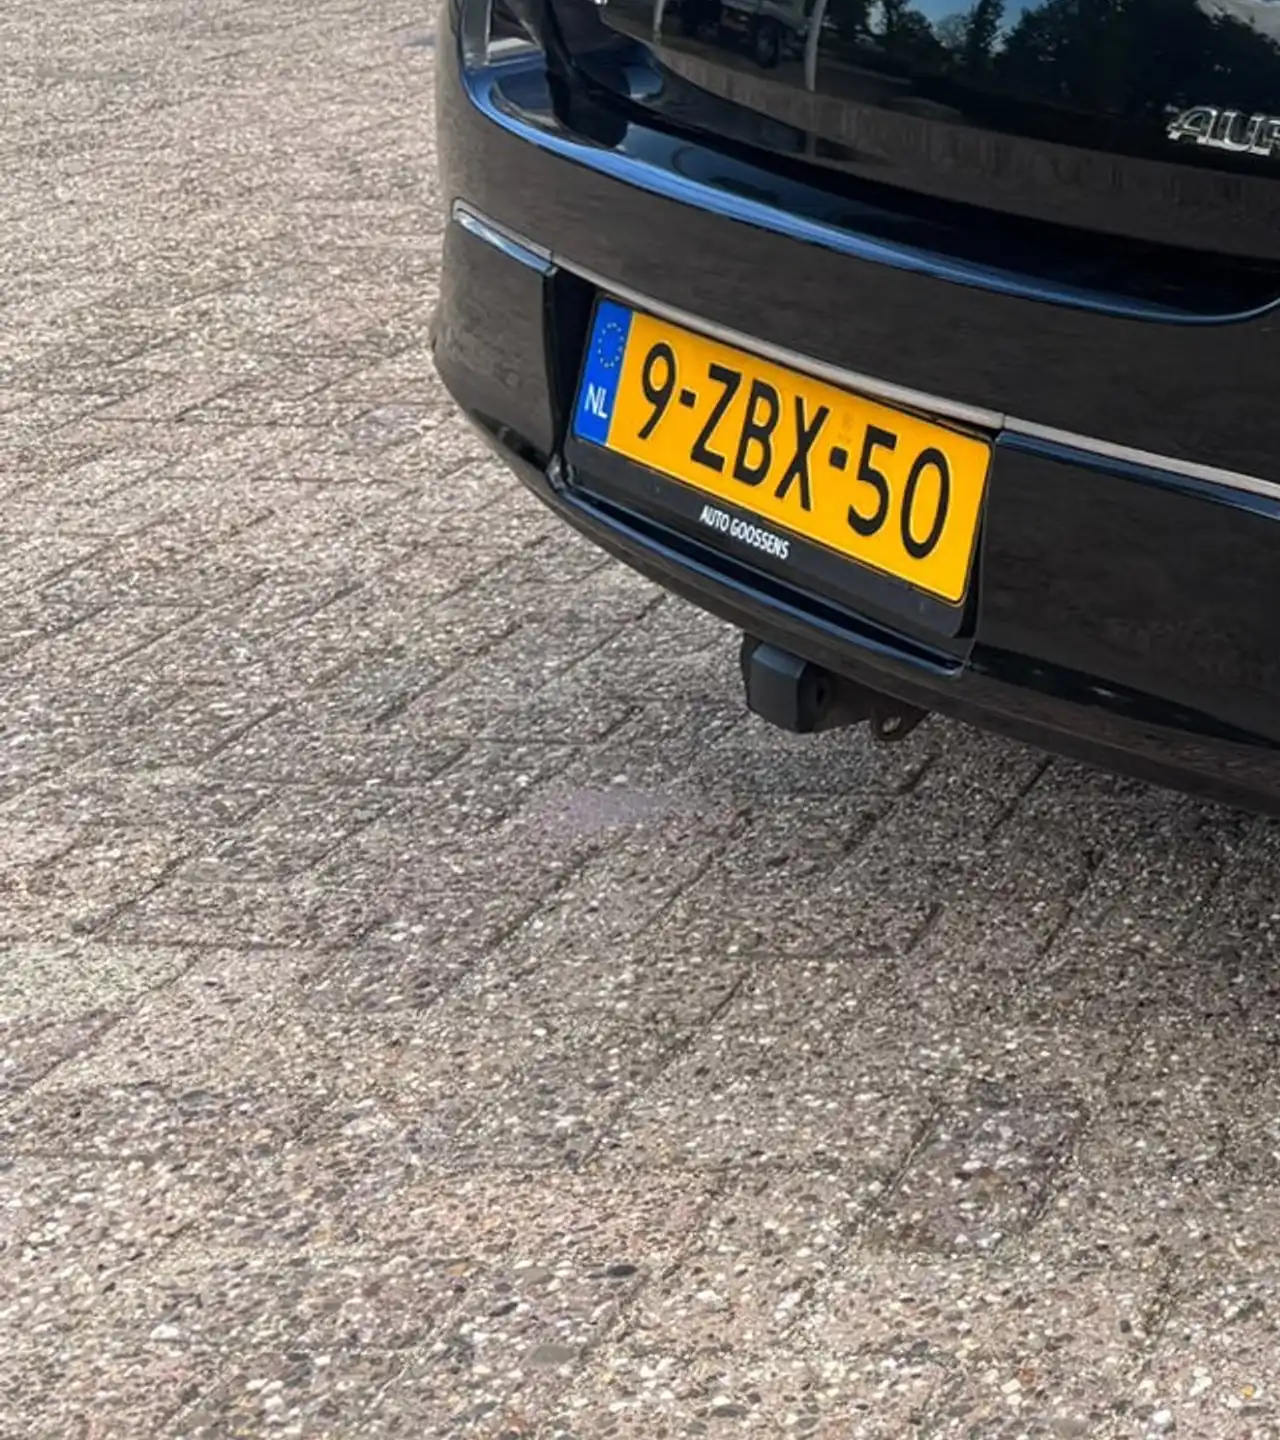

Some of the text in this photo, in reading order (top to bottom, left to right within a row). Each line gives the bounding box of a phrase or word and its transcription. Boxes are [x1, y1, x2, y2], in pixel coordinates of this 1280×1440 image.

[584, 383, 609, 420] NL
[637, 342, 950, 560] 9-ZBX-50
[699, 505, 791, 560] AUTO GOOSSENS
